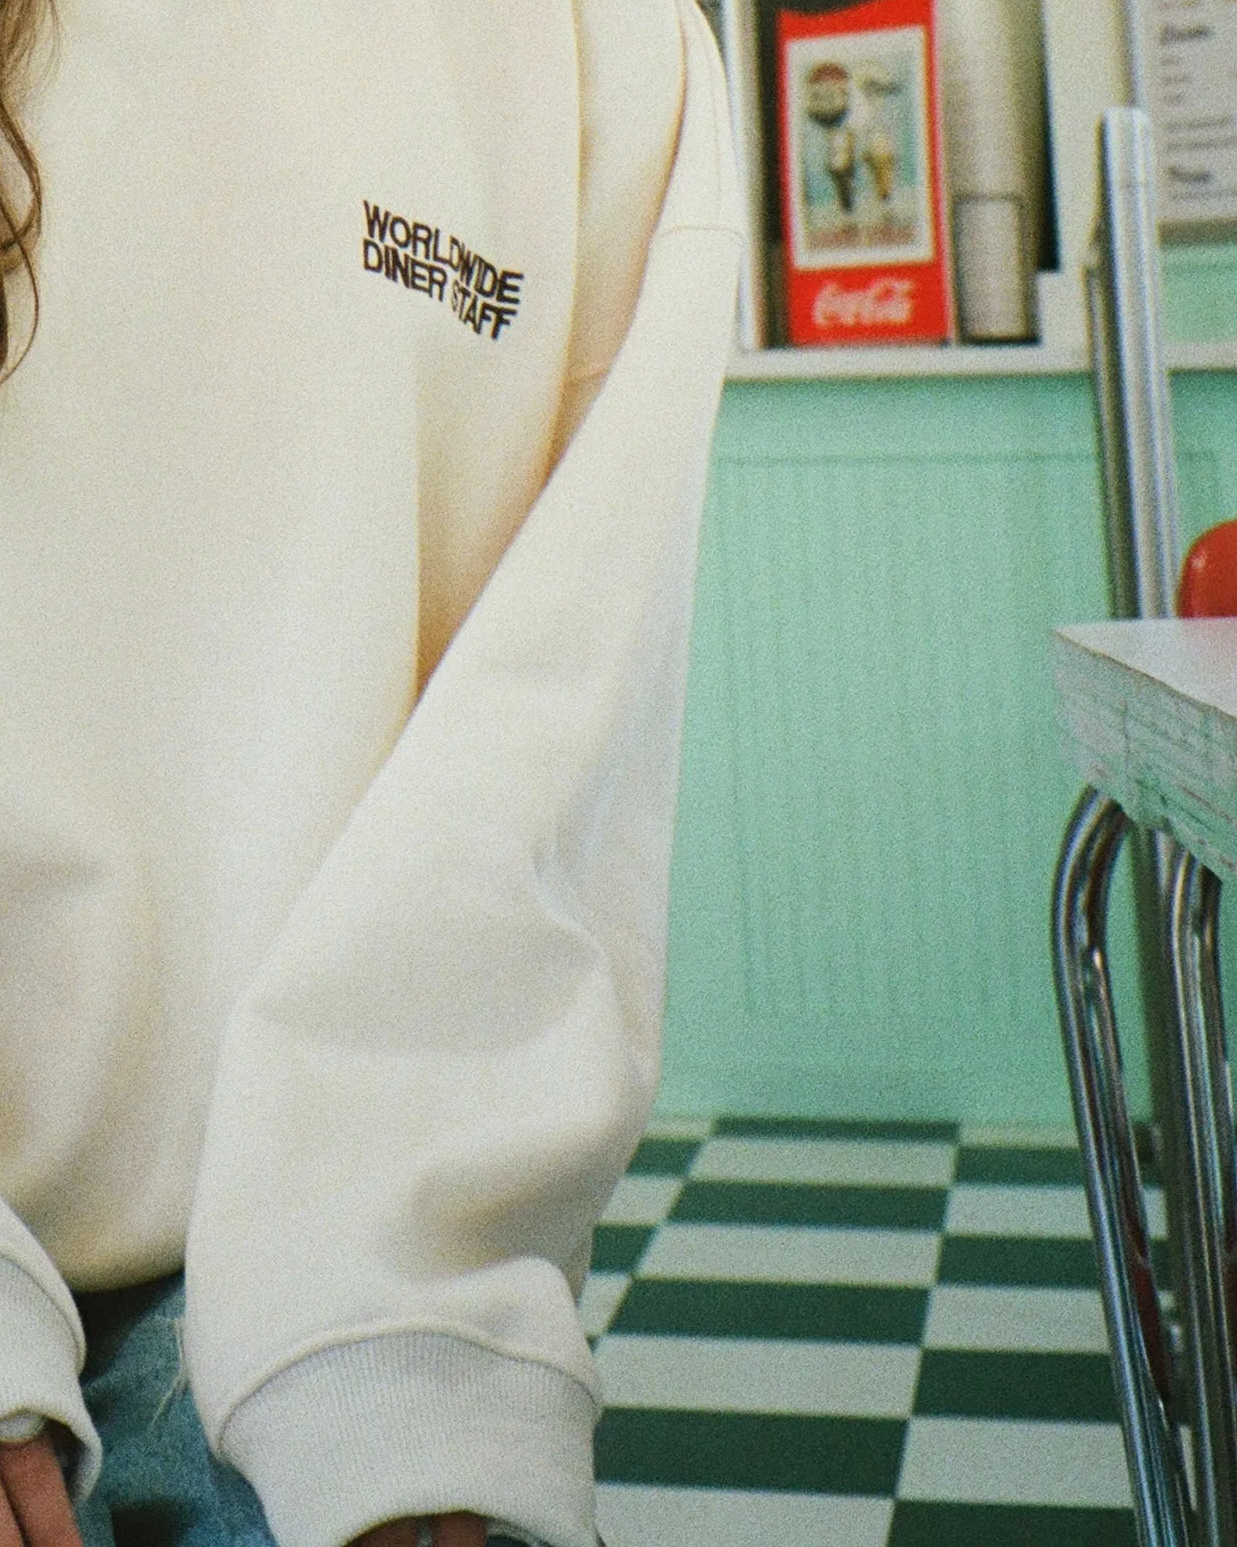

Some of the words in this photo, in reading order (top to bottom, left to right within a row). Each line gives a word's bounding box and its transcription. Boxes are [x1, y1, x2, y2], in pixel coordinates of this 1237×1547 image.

[362, 237, 448, 303] DINER
[451, 278, 518, 340] STAFF
[363, 200, 524, 304] WORLDWIDE
